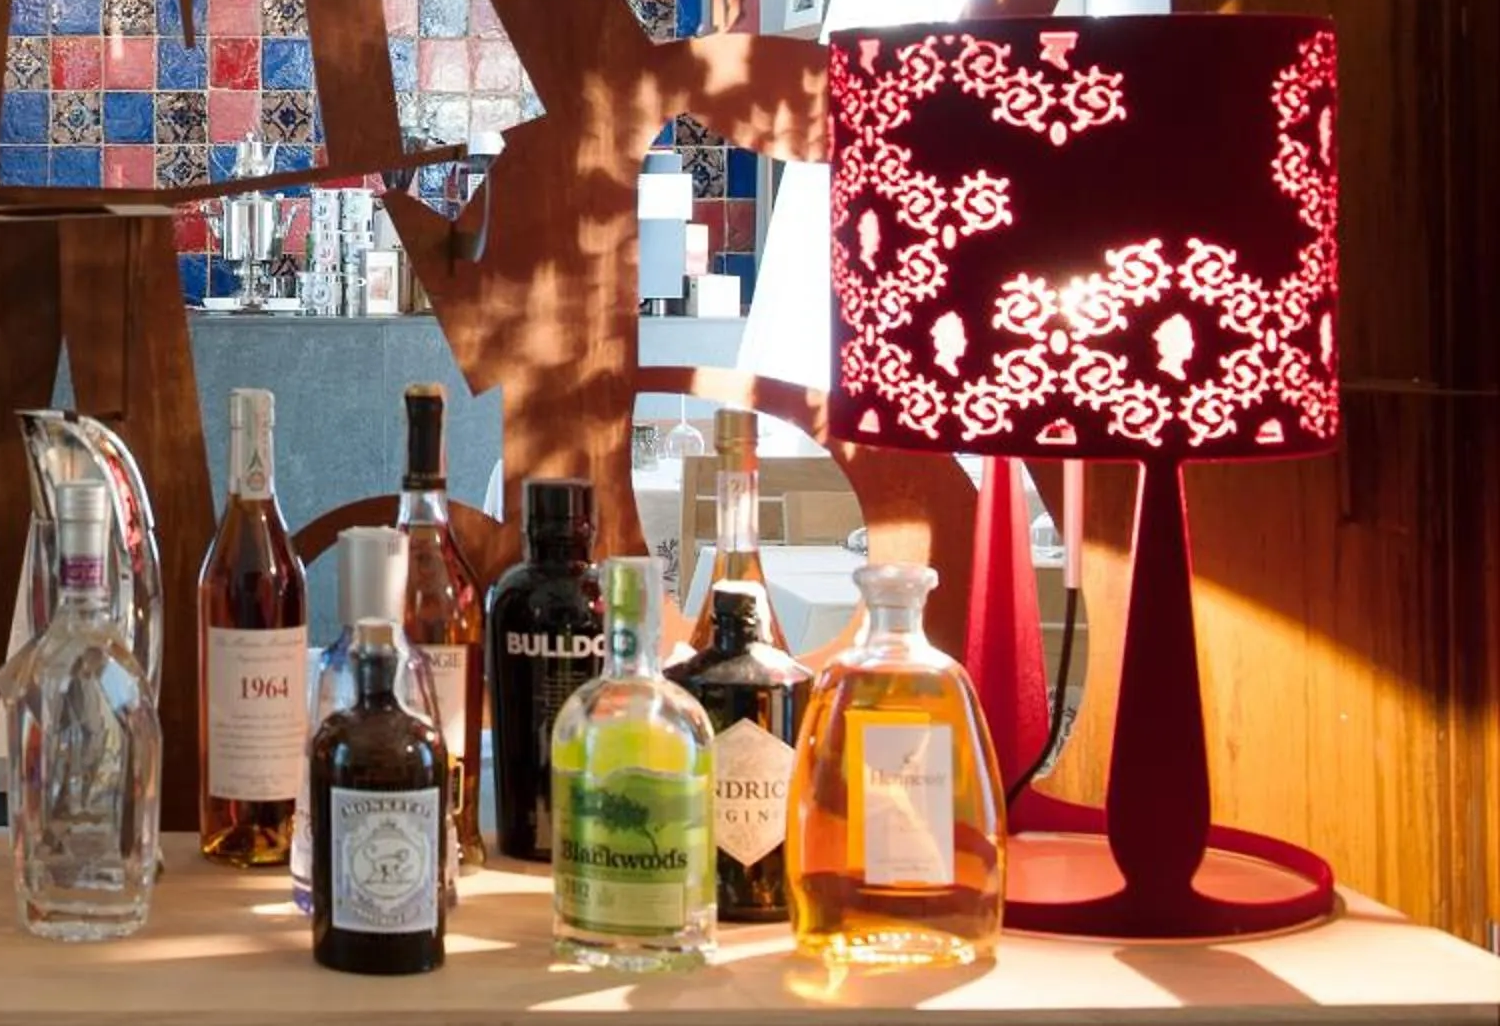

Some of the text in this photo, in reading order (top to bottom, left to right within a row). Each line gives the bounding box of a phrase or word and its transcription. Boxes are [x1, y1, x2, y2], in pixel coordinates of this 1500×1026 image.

[506, 631, 606, 658] BULLDO
[241, 676, 290, 700] 1964
[725, 809, 770, 824] GIN
[560, 839, 688, 871] Blackwoods
